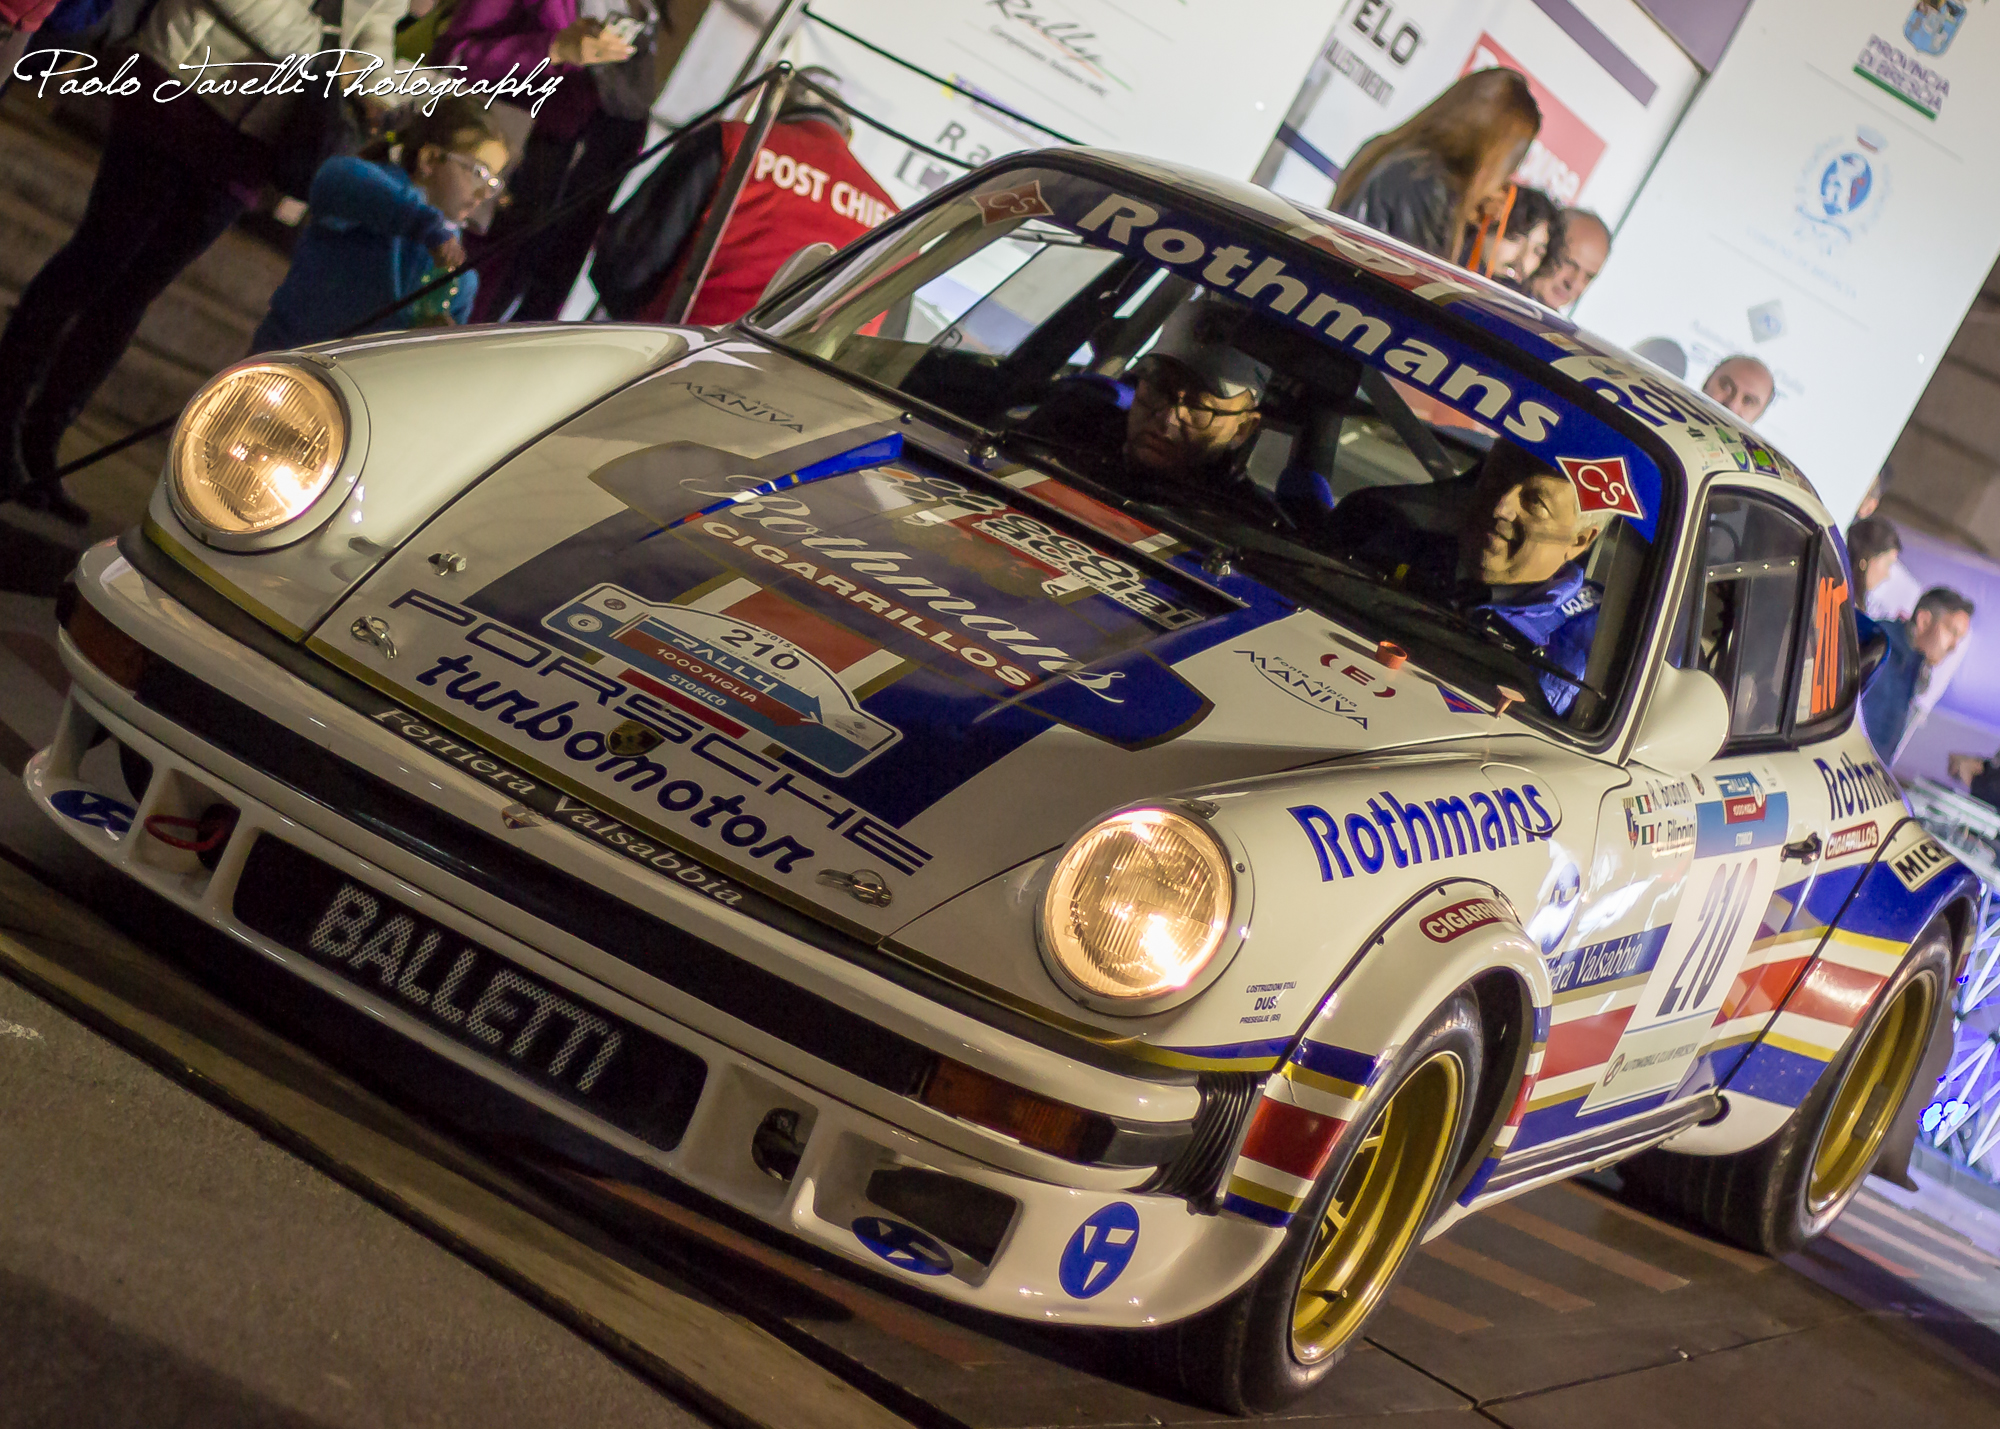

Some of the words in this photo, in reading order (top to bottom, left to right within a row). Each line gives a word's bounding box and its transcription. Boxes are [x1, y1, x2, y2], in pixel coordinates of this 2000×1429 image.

[1341, 0, 1420, 66] ELO
[1866, 33, 1950, 98] PROVINCIA
[753, 148, 830, 203] POST
[830, 180, 896, 229] CHIE
[1076, 192, 1561, 443] Rothmans
[669, 381, 804, 434] MANIVA
[679, 474, 1126, 703] Rothmans
[702, 521, 1031, 686] CIGARRILLOS
[672, 637, 778, 693] RALLY
[720, 628, 800, 670] 210
[761, 630, 792, 649] 2015
[668, 674, 727, 707] STORICO
[1232, 650, 1368, 731] MANIVA
[1273, 656, 1309, 679] Fonte
[1313, 680, 1358, 708] Alpina
[388, 588, 934, 877] PORSCHE
[415, 654, 815, 873] turbomotor
[371, 708, 538, 795] Ferriera
[551, 795, 744, 906] Valsabbia
[1286, 783, 1555, 882] Rothmans
[1826, 824, 1878, 857] CIGARRILLOS
[1895, 840, 1951, 883] MICH
[1576, 933, 1644, 985] Valsabbia
[1655, 857, 1759, 1018] 210
[310, 882, 622, 1094] BALLETTI
